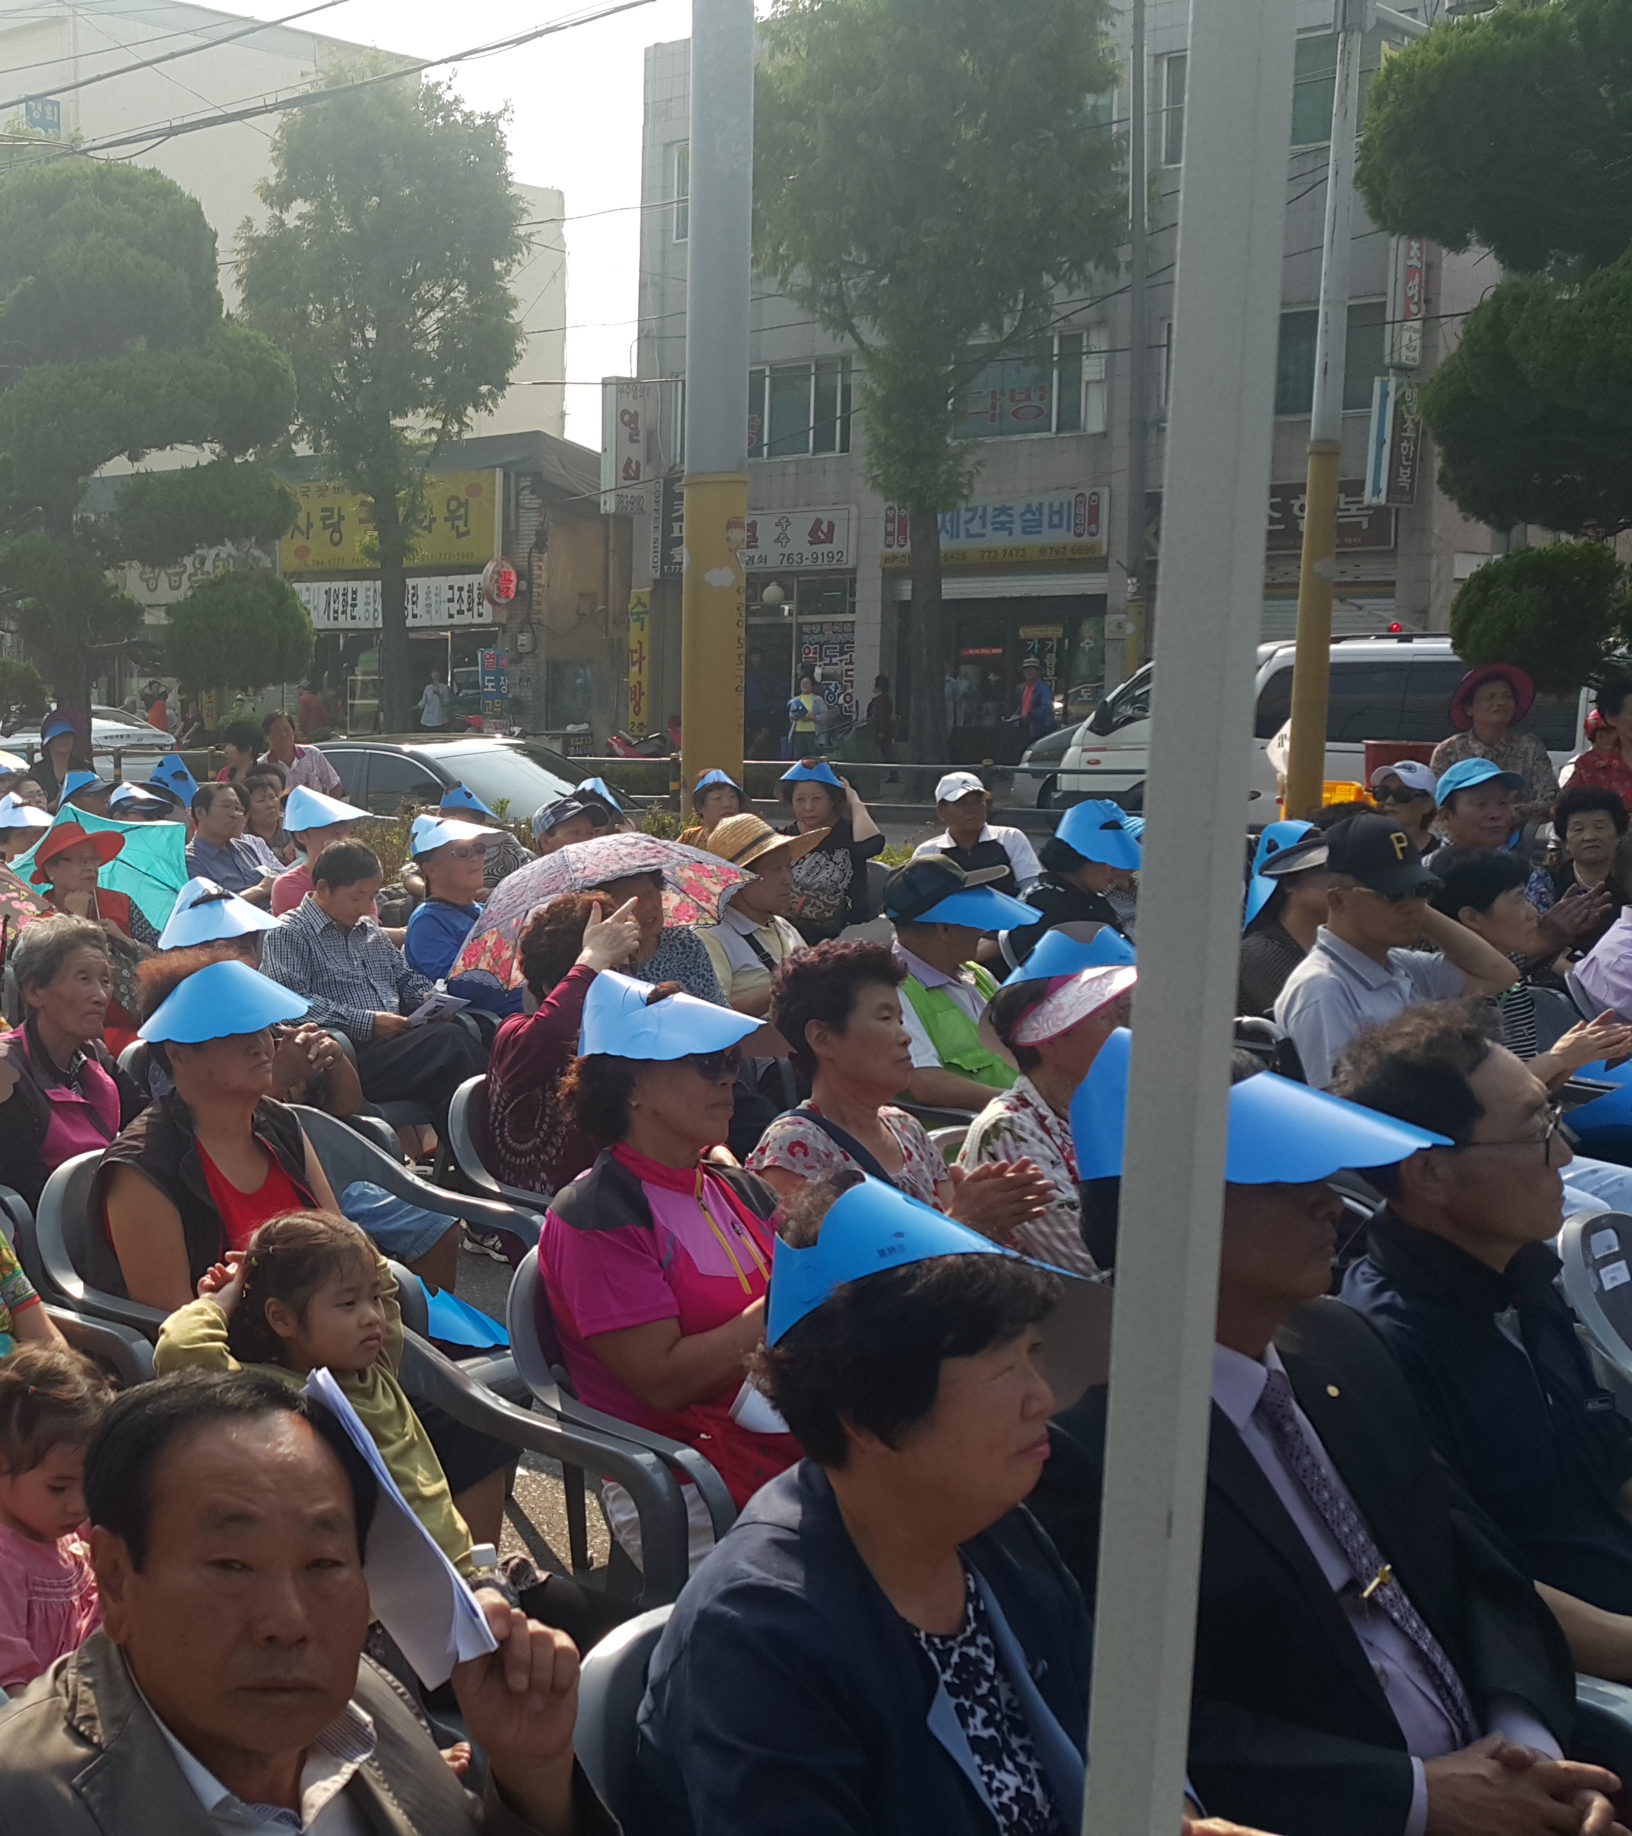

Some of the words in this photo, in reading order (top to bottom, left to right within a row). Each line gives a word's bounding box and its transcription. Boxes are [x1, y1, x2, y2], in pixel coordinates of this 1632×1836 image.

[938, 501, 1073, 540] 제건축설비
[778, 550, 845, 567] 763-9192
[1389, 831, 1408, 860] P
